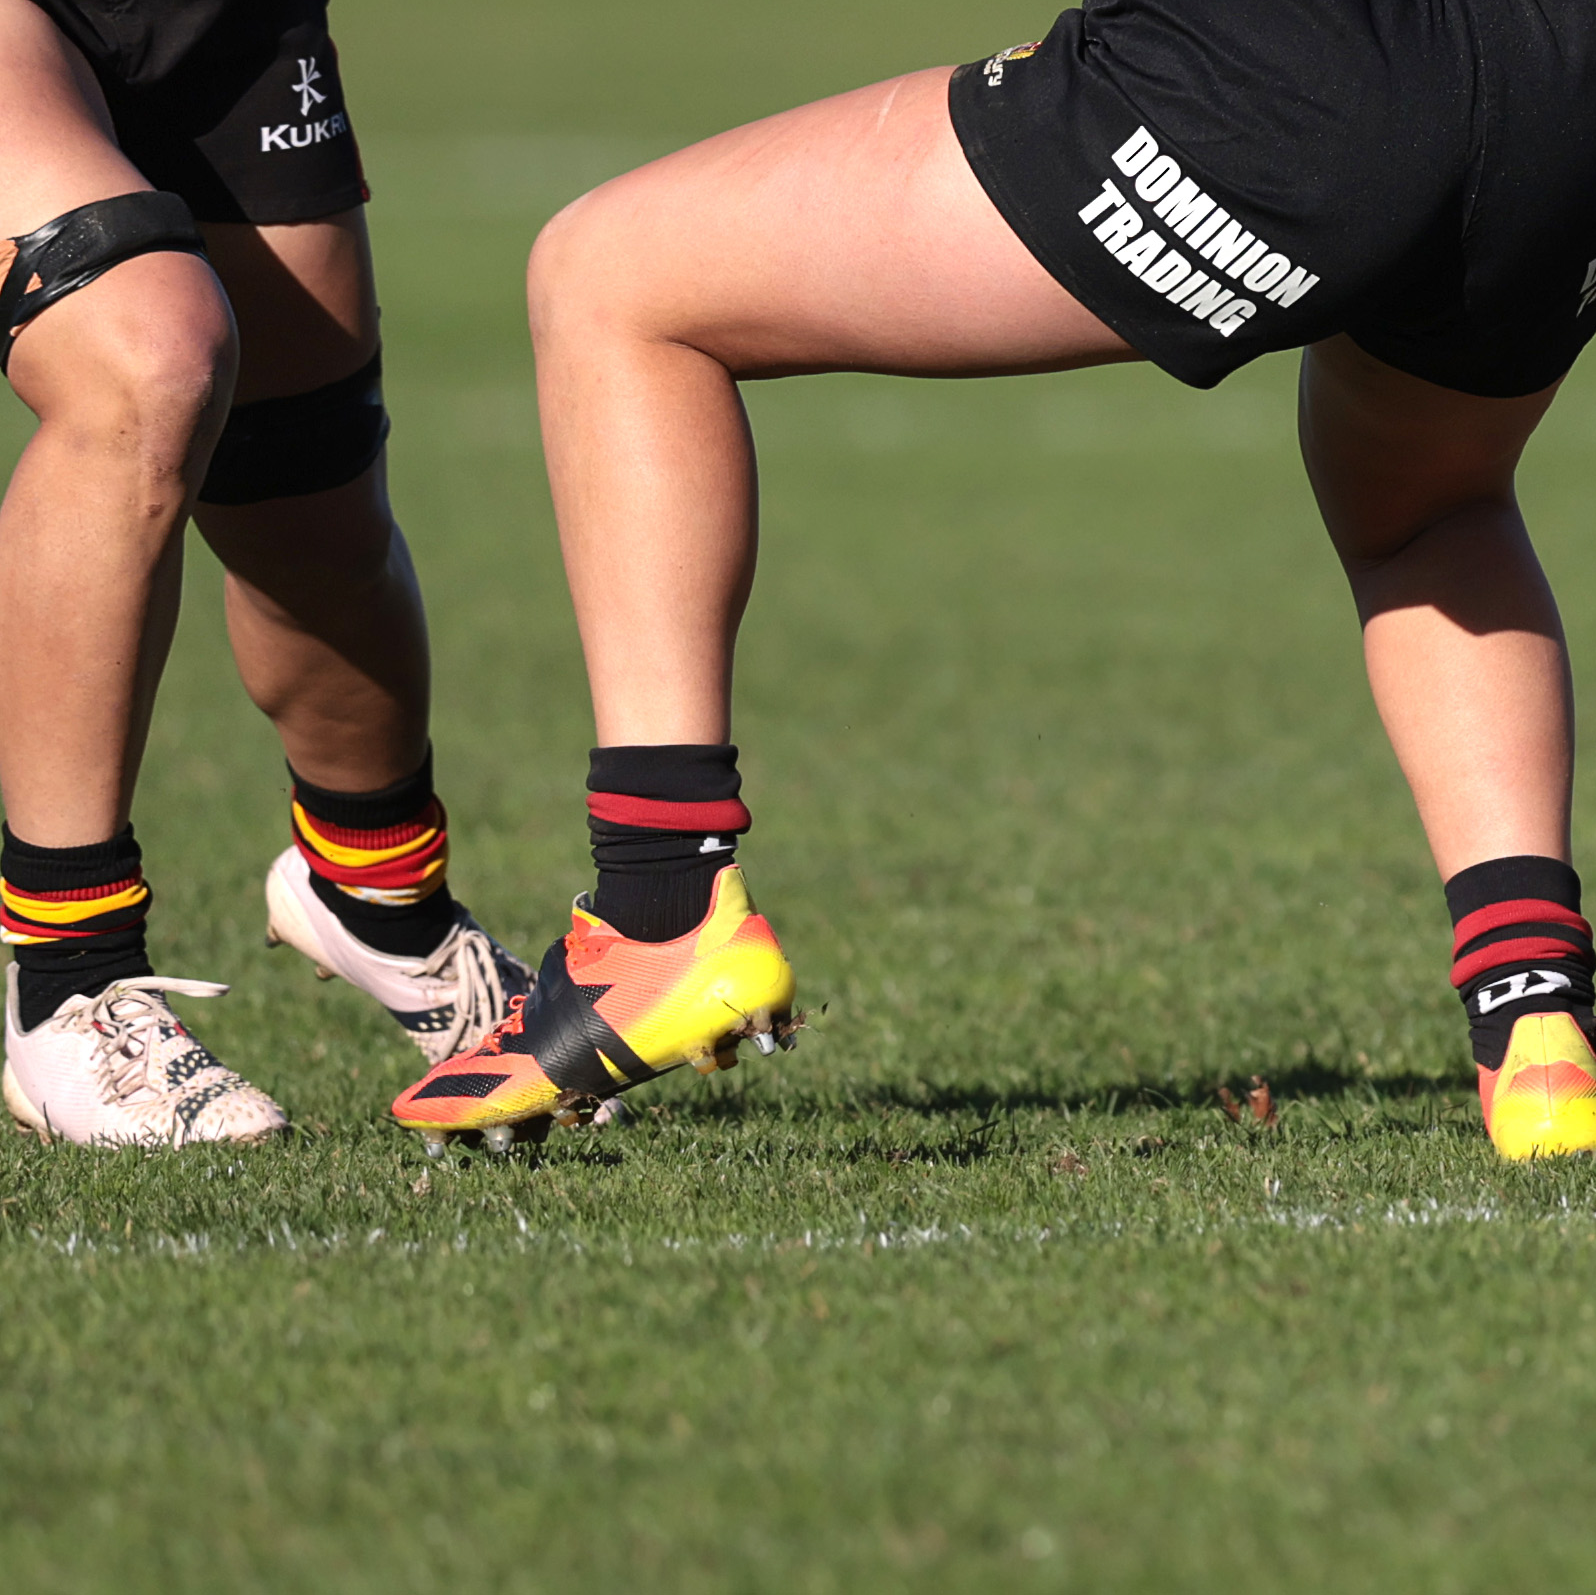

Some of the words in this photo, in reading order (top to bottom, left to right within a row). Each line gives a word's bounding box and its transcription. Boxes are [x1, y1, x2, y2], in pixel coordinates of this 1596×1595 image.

[261, 110, 347, 153] KUKRI
[1077, 179, 1257, 337] TRADING
[1111, 125, 1321, 309] DOMINION
